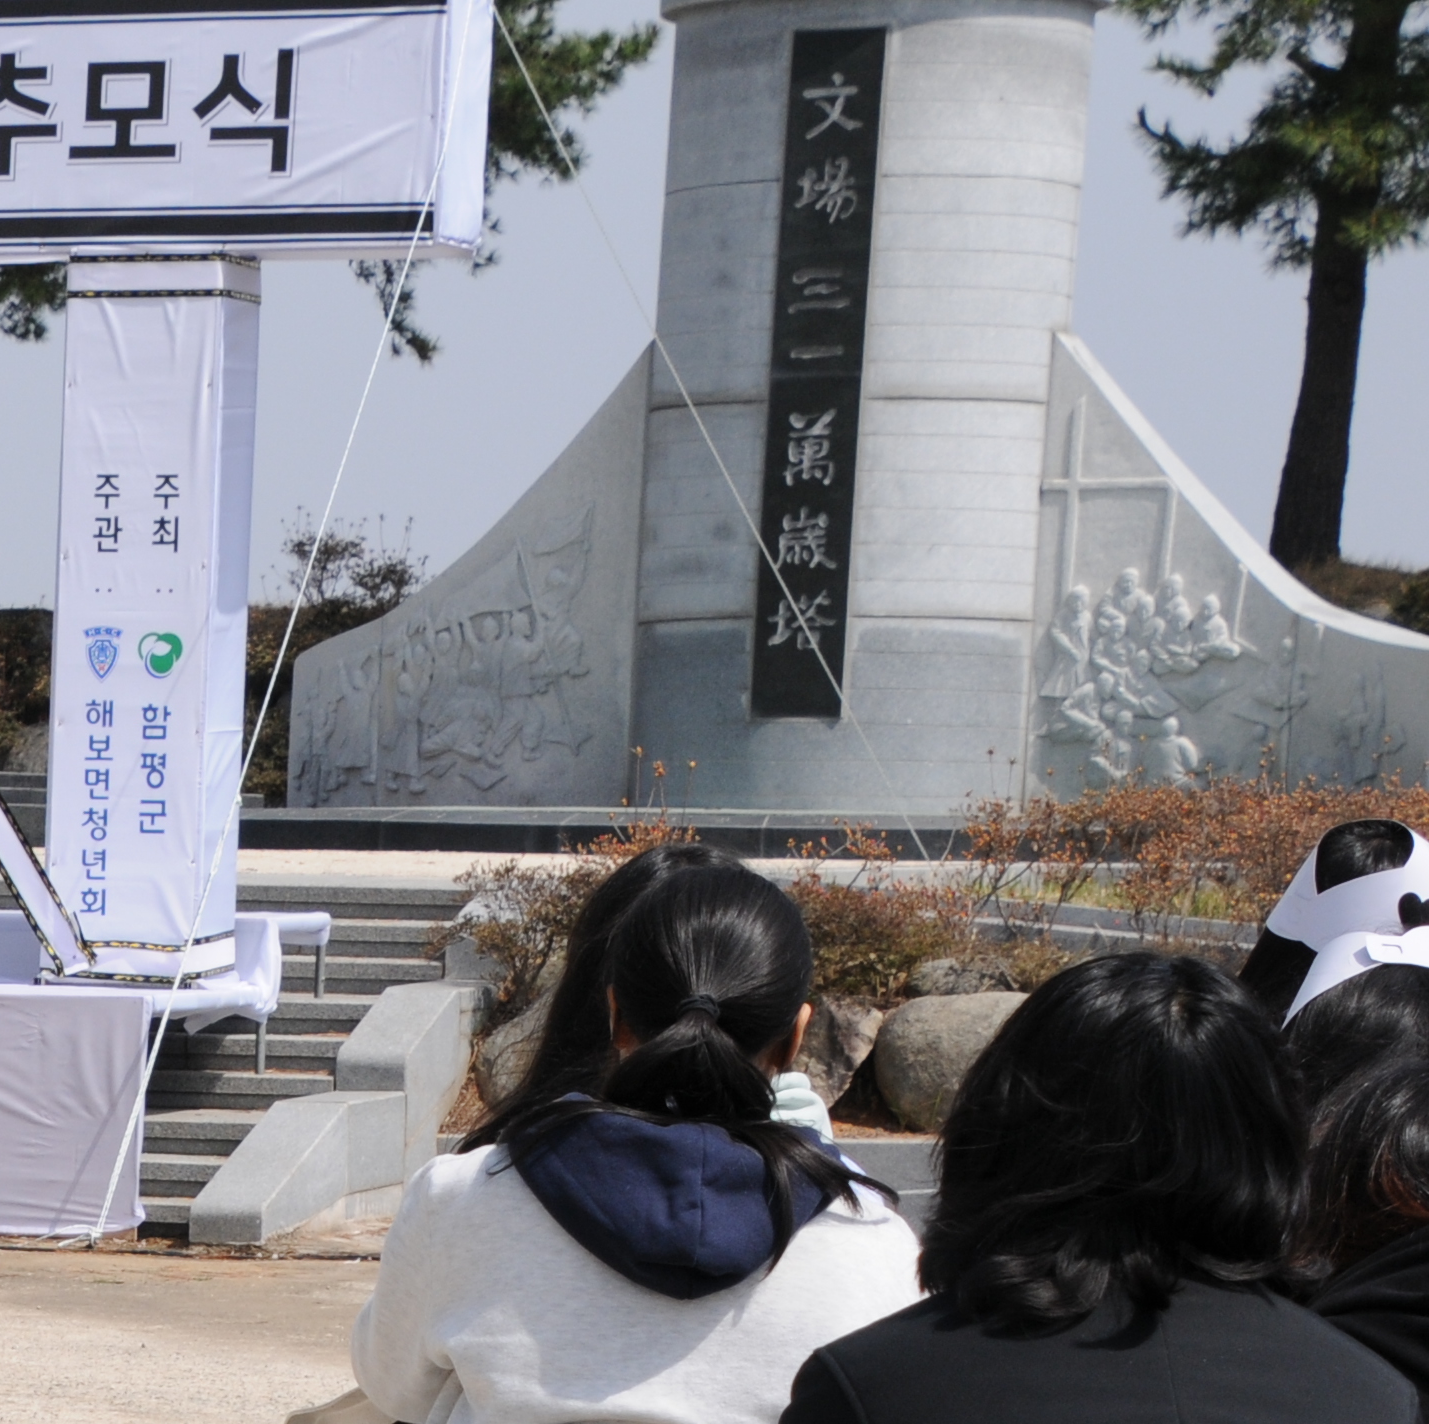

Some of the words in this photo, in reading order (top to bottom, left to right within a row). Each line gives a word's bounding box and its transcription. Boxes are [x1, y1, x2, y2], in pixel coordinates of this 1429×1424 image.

[93, 474, 123, 553] 주관
[151, 474, 181, 553] 주최
[80, 699, 115, 917] 해보면청년회
[139, 704, 172, 835] 함평군
